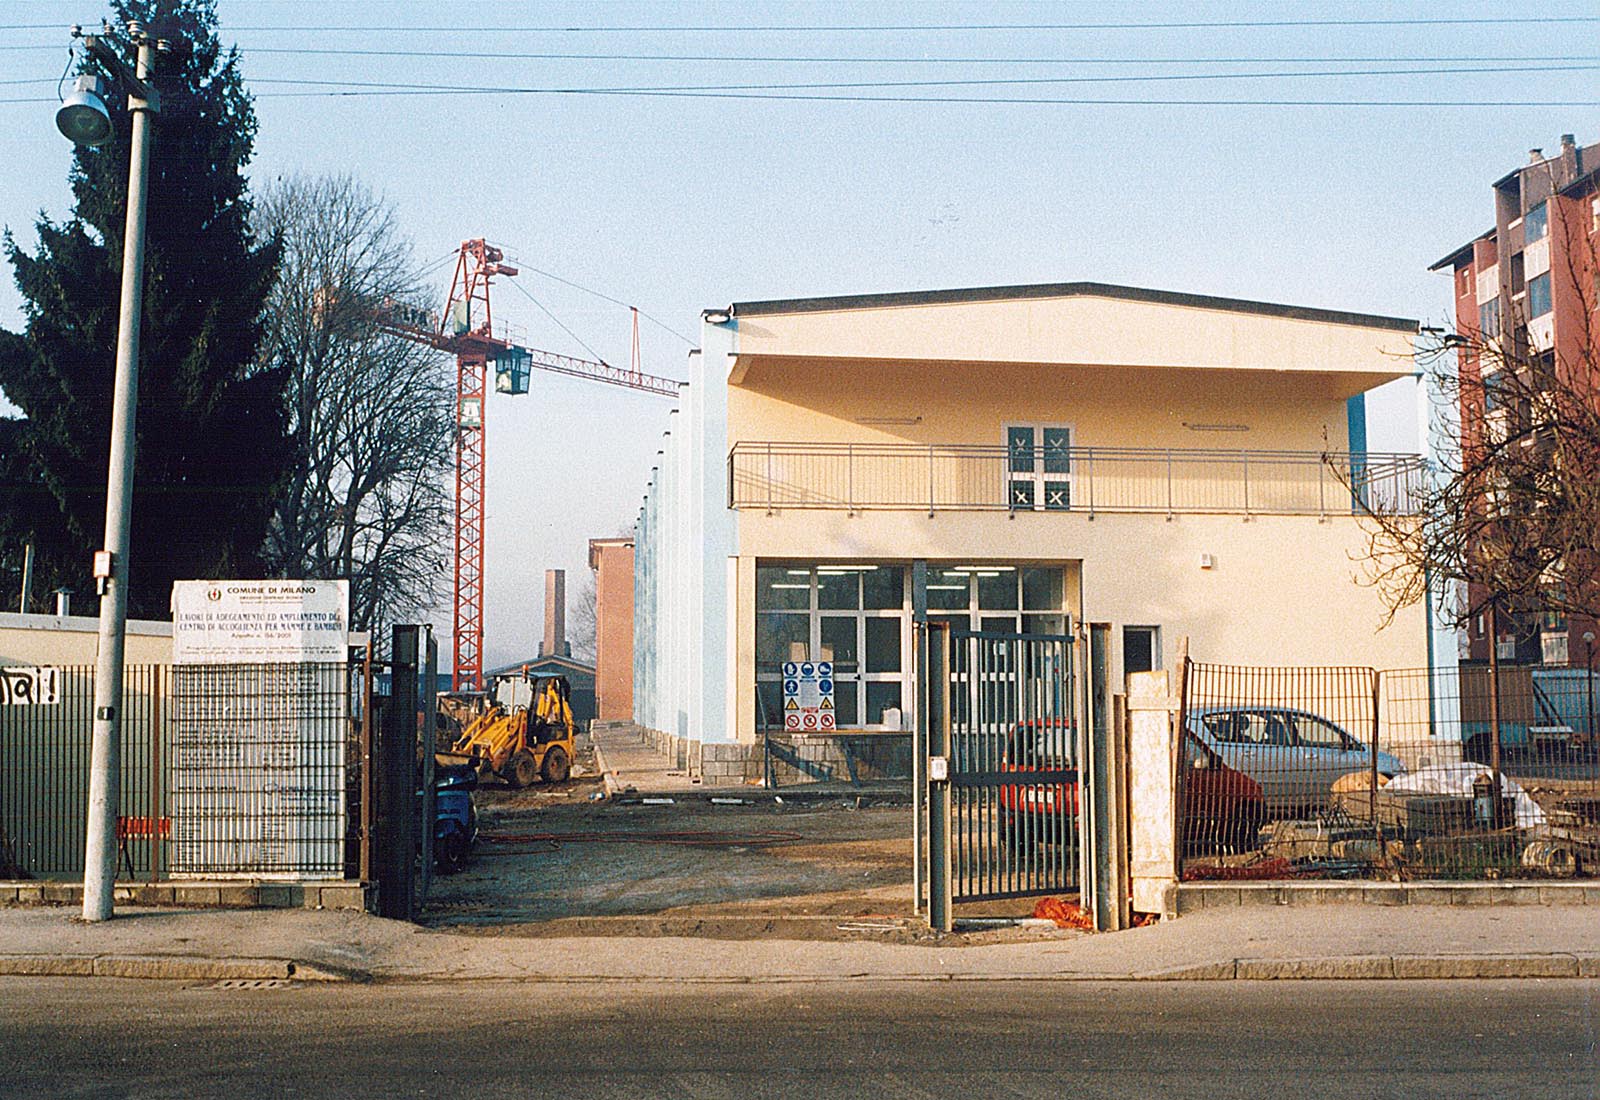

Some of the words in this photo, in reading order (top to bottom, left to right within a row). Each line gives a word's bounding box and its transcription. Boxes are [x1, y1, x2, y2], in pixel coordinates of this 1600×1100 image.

[281, 586, 316, 594] MILANO
[180, 613, 204, 621] LAVORI
[206, 613, 213, 621] DI
[267, 613, 277, 621] ED
[280, 613, 326, 621] AMPLIAMENTO
[179, 623, 206, 631] CENTRO
[208, 623, 215, 631] DI
[218, 623, 263, 631] ACCOGLIENZA
[265, 623, 278, 631] PER
[281, 623, 304, 631] MAMME
